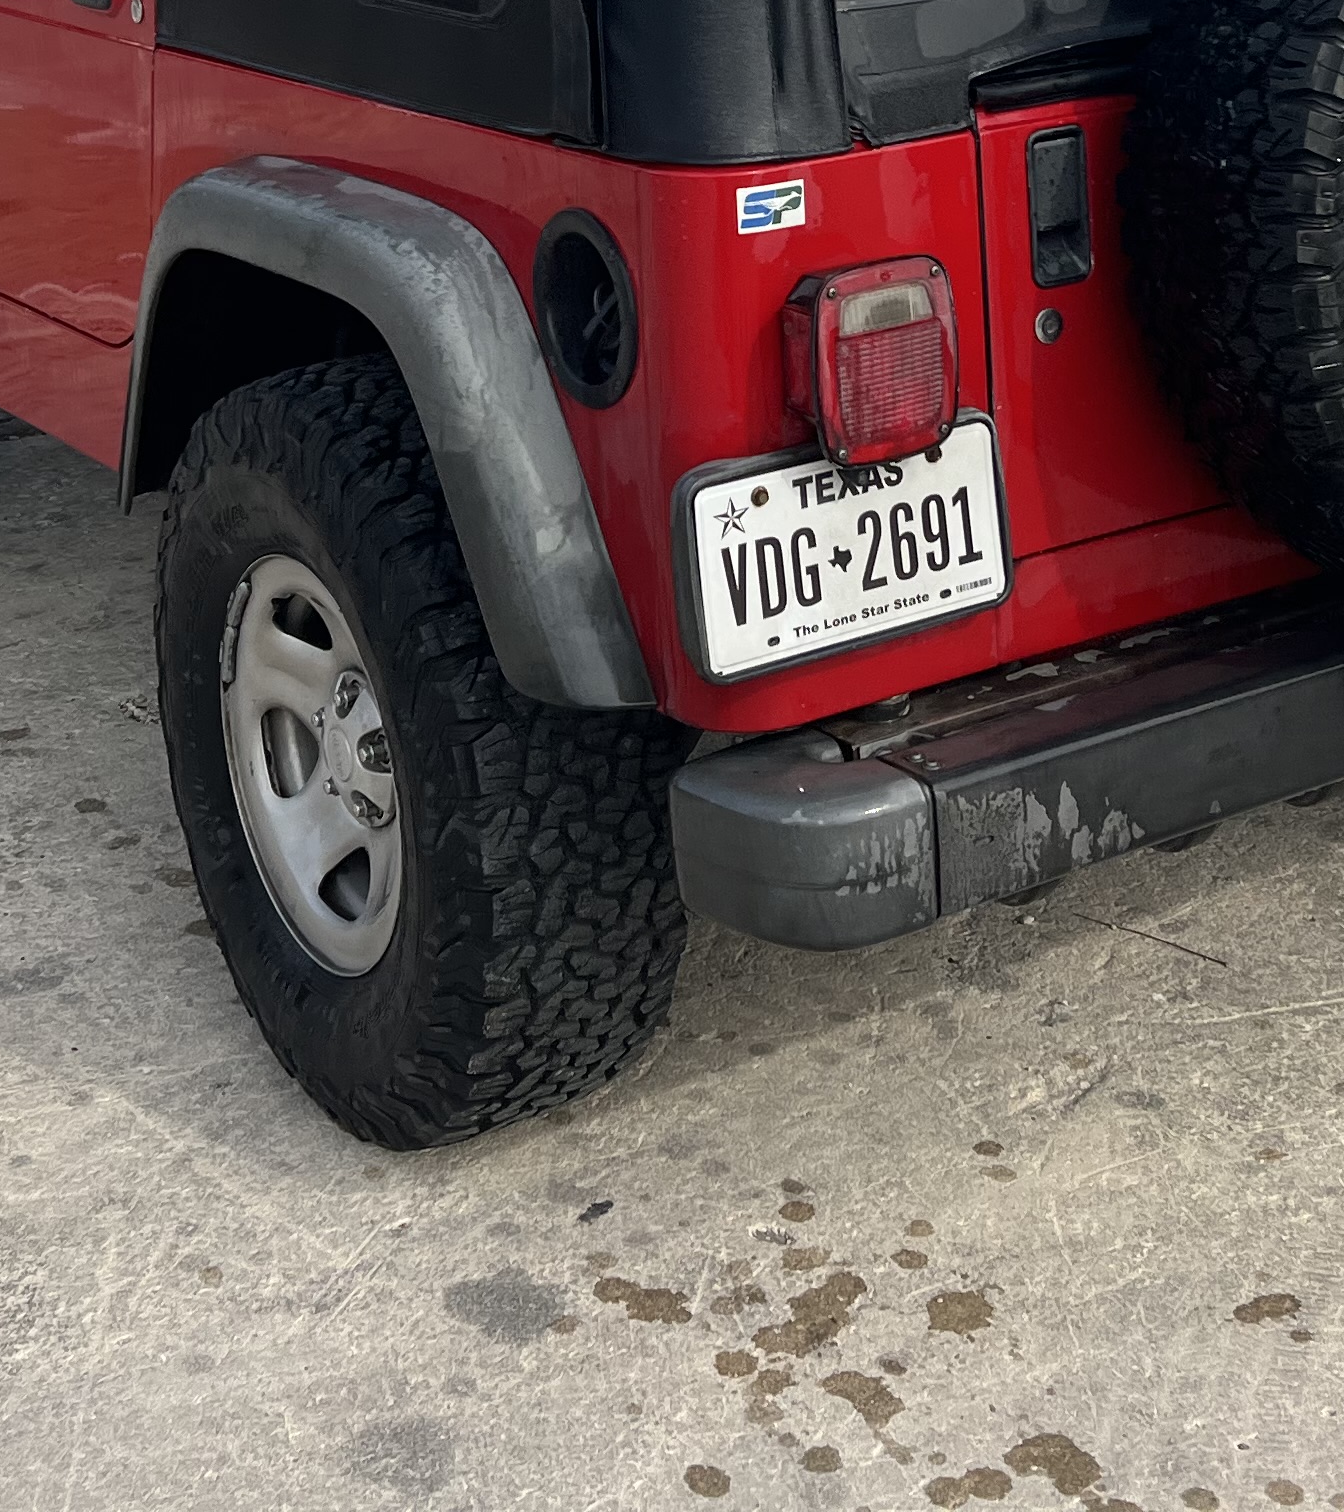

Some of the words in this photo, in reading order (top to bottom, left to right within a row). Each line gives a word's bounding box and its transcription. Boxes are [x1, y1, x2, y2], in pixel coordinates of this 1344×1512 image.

[792, 460, 904, 509] TEXAS
[721, 527, 823, 627] VDG
[856, 486, 983, 592] 2691
[793, 622, 819, 639] The
[823, 612, 857, 630] Lone
[861, 602, 890, 620] Star
[893, 591, 930, 611] State
